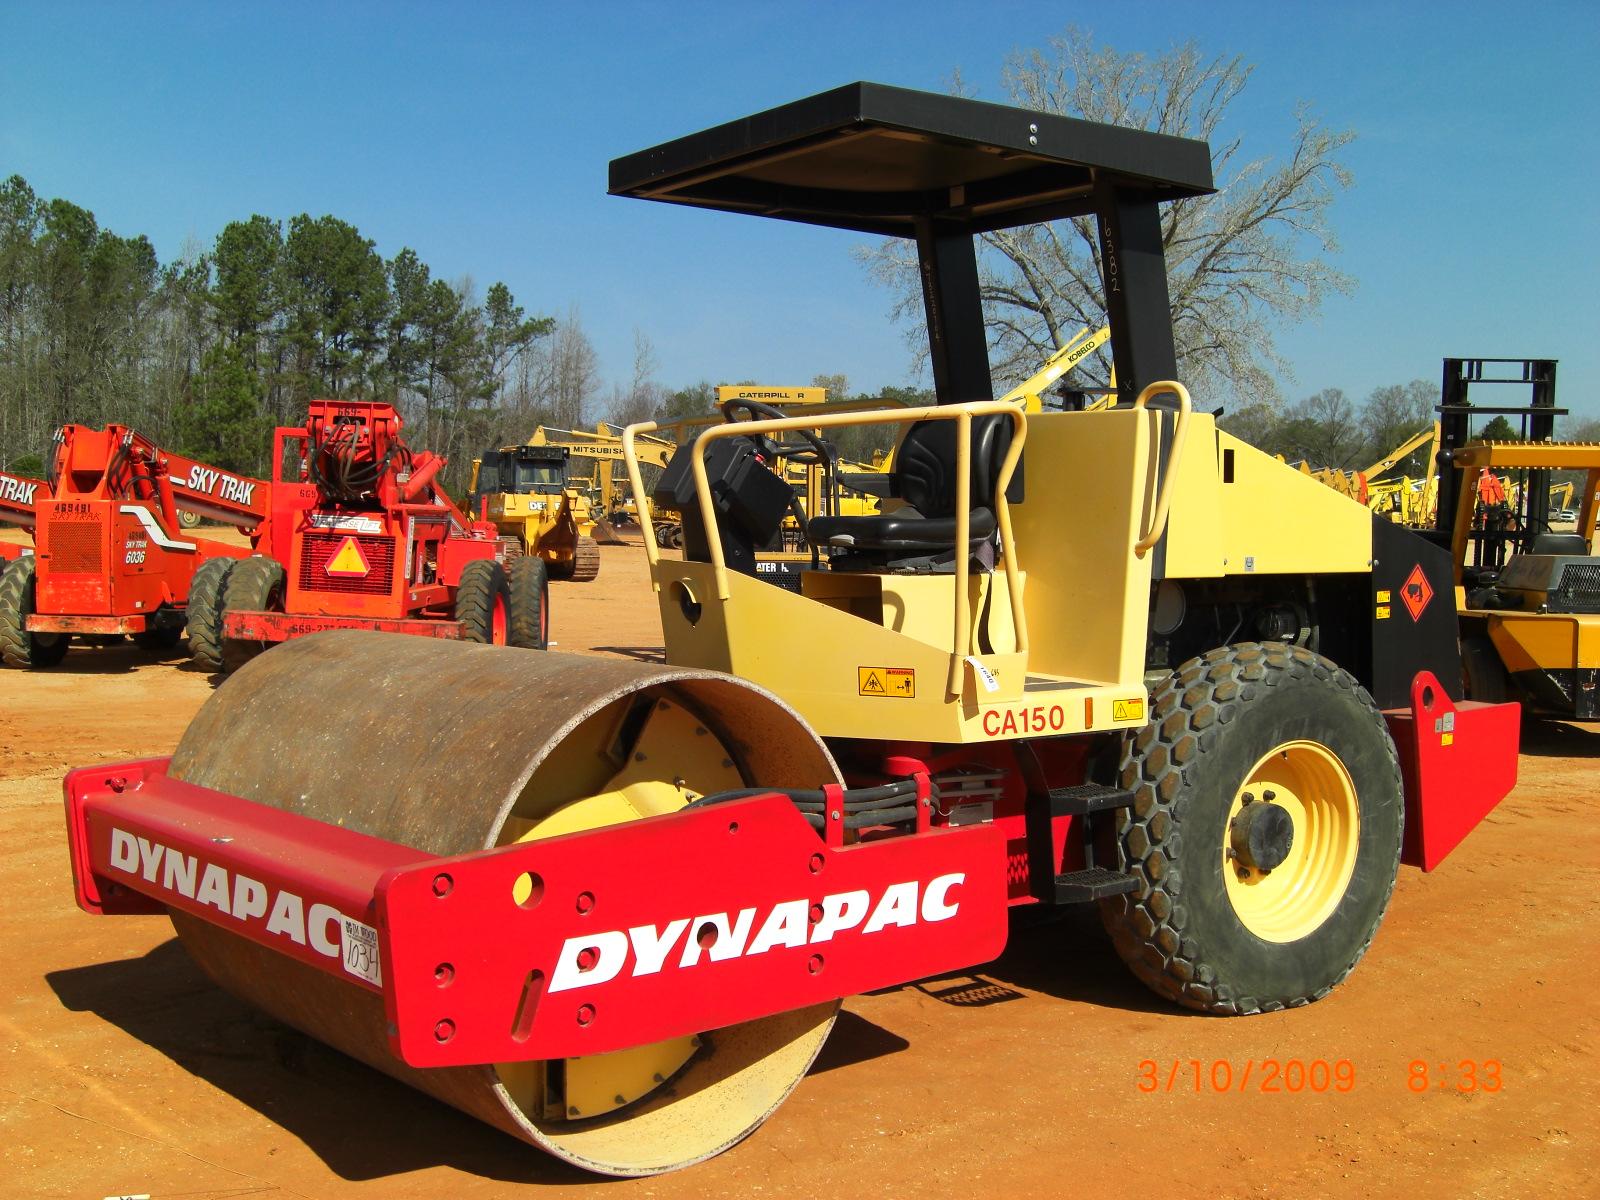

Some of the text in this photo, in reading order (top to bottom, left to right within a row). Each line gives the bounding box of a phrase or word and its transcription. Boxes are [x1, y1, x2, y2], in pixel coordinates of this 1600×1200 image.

[1067, 341, 1095, 363] KOBELCO
[0, 475, 38, 505] TRAK
[187, 465, 256, 506] SKY TRAK
[125, 541, 136, 549] SKY
[125, 551, 146, 564] 6036
[982, 705, 1065, 737] CA150
[110, 827, 342, 958] DYNAPAC
[548, 873, 966, 994] DYNAPAC
[347, 940, 379, 978] 1034
